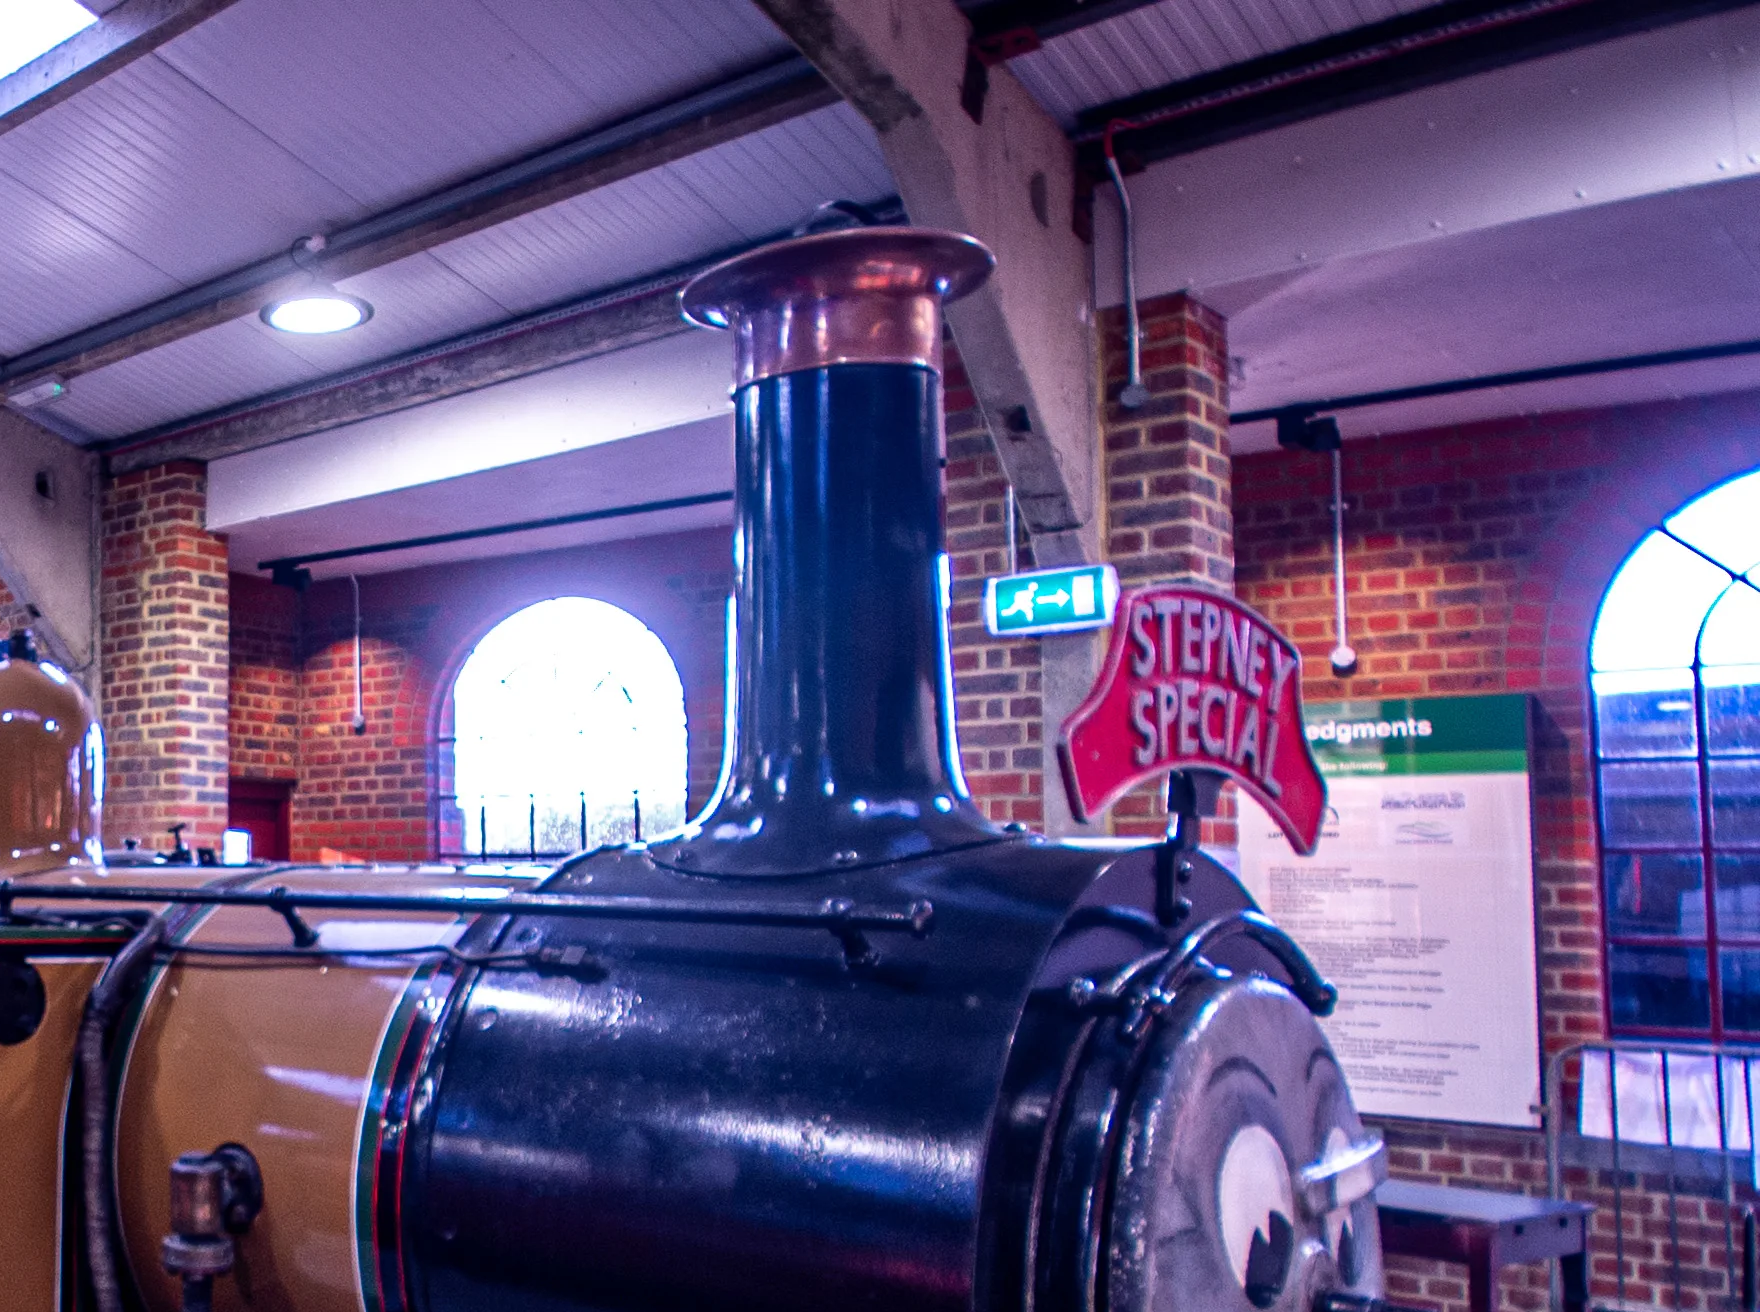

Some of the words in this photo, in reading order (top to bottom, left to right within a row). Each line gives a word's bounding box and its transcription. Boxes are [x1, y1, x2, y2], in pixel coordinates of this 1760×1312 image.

[1129, 597, 1297, 713] STEPNEY
[1131, 679, 1283, 798] SPECIAL
[1305, 717, 1433, 743] edgments
[1339, 760, 1386, 772] following
